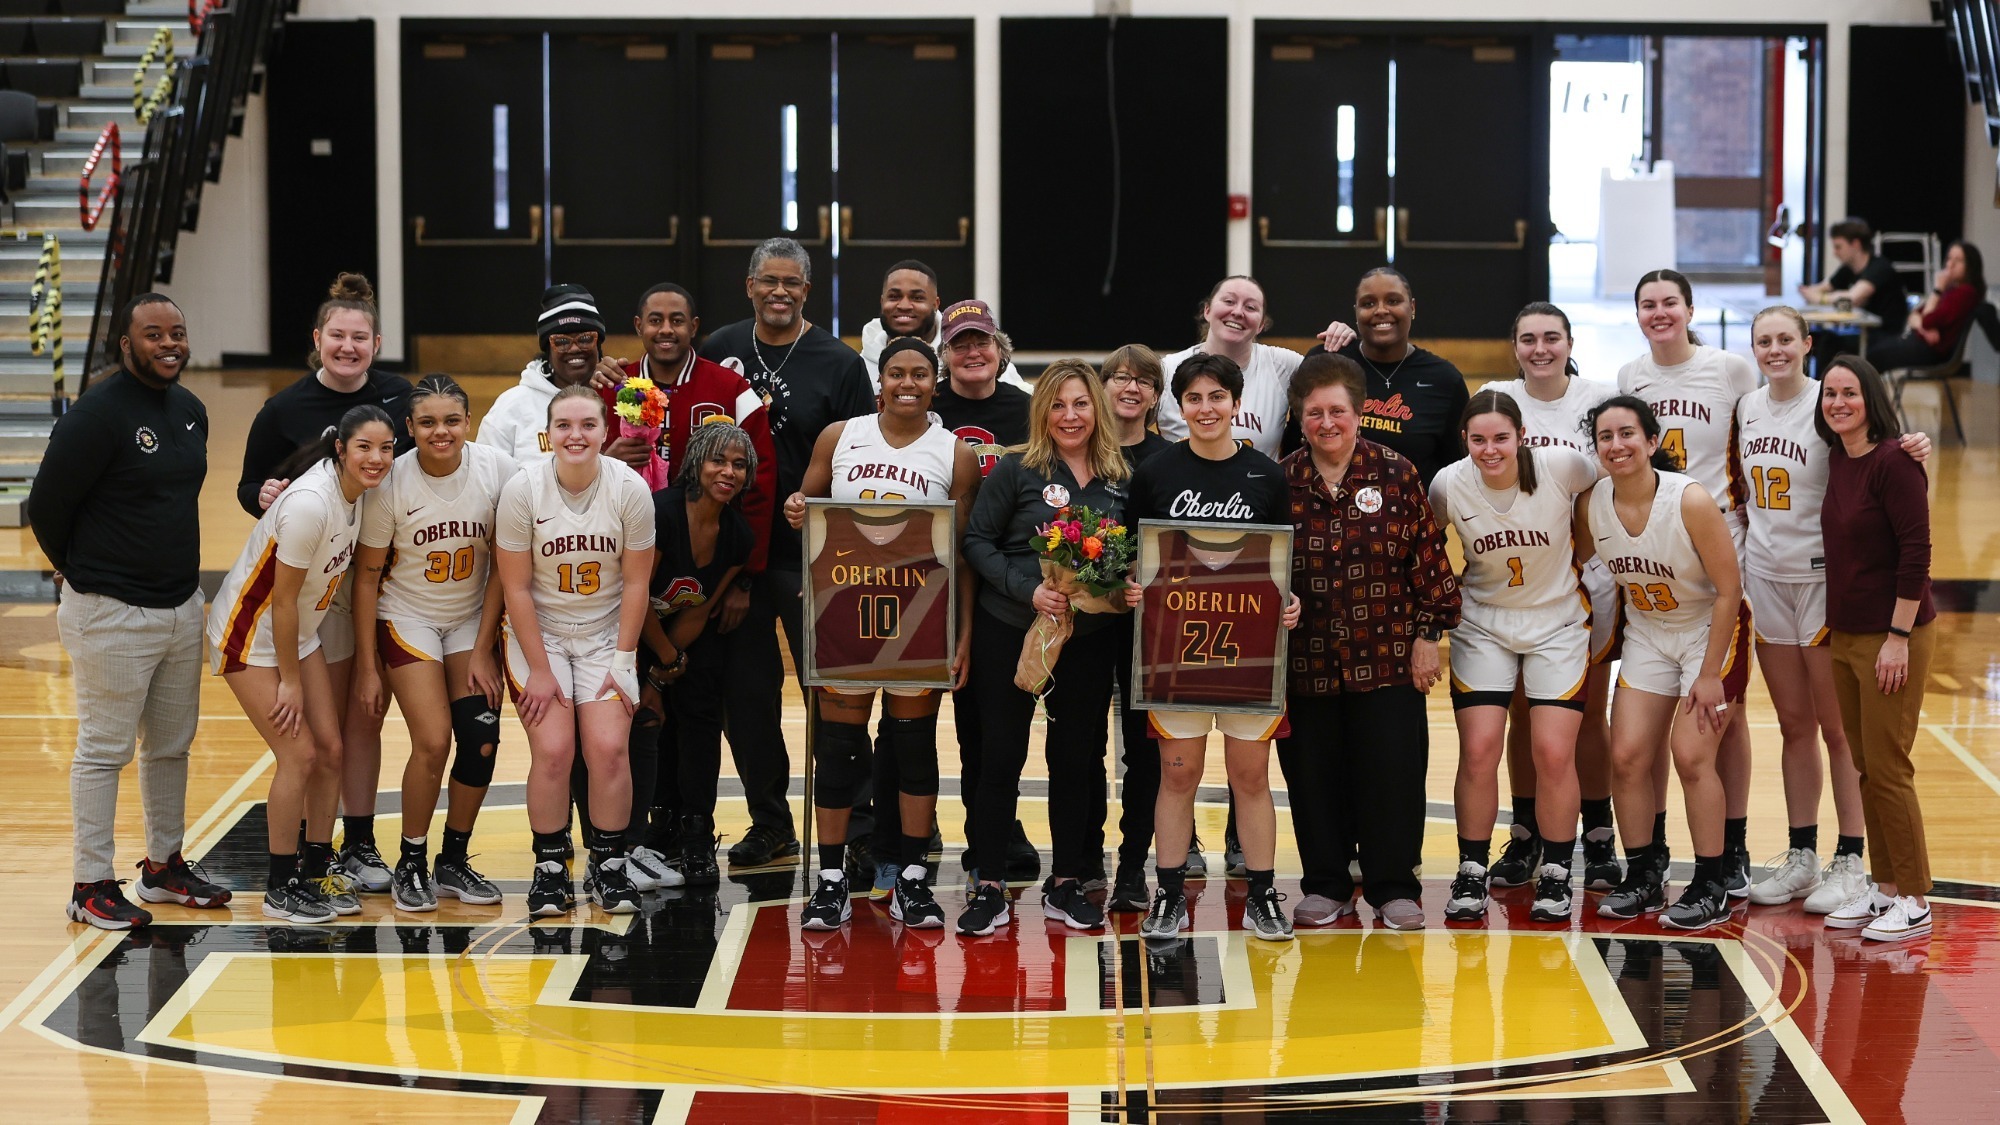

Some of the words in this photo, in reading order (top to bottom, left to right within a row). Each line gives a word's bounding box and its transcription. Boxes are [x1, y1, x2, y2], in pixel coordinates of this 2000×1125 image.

[948, 305, 982, 322] OBERLIN
[1363, 393, 1413, 421] erlin
[1650, 399, 1711, 425] BERLIN
[1359, 415, 1402, 433] KETBALL
[1743, 436, 1808, 467] OBERLIN
[847, 463, 929, 498] OBERLIN
[1751, 465, 1791, 510] 12
[1169, 489, 1254, 520] Oberlin
[413, 521, 488, 547] OBERLIN
[541, 534, 617, 557] OBERLIN
[1473, 530, 1550, 554] OBERLIN
[424, 545, 475, 584] 30
[557, 561, 602, 596] 13
[831, 564, 927, 588] OBERLIN
[1506, 556, 1524, 588] 1
[1608, 556, 1676, 581] OBERLIN
[315, 570, 347, 611] 1
[1166, 591, 1262, 615] OBERLIN
[1627, 582, 1680, 612] 33
[857, 594, 900, 640] 10
[1181, 620, 1240, 667] 24
